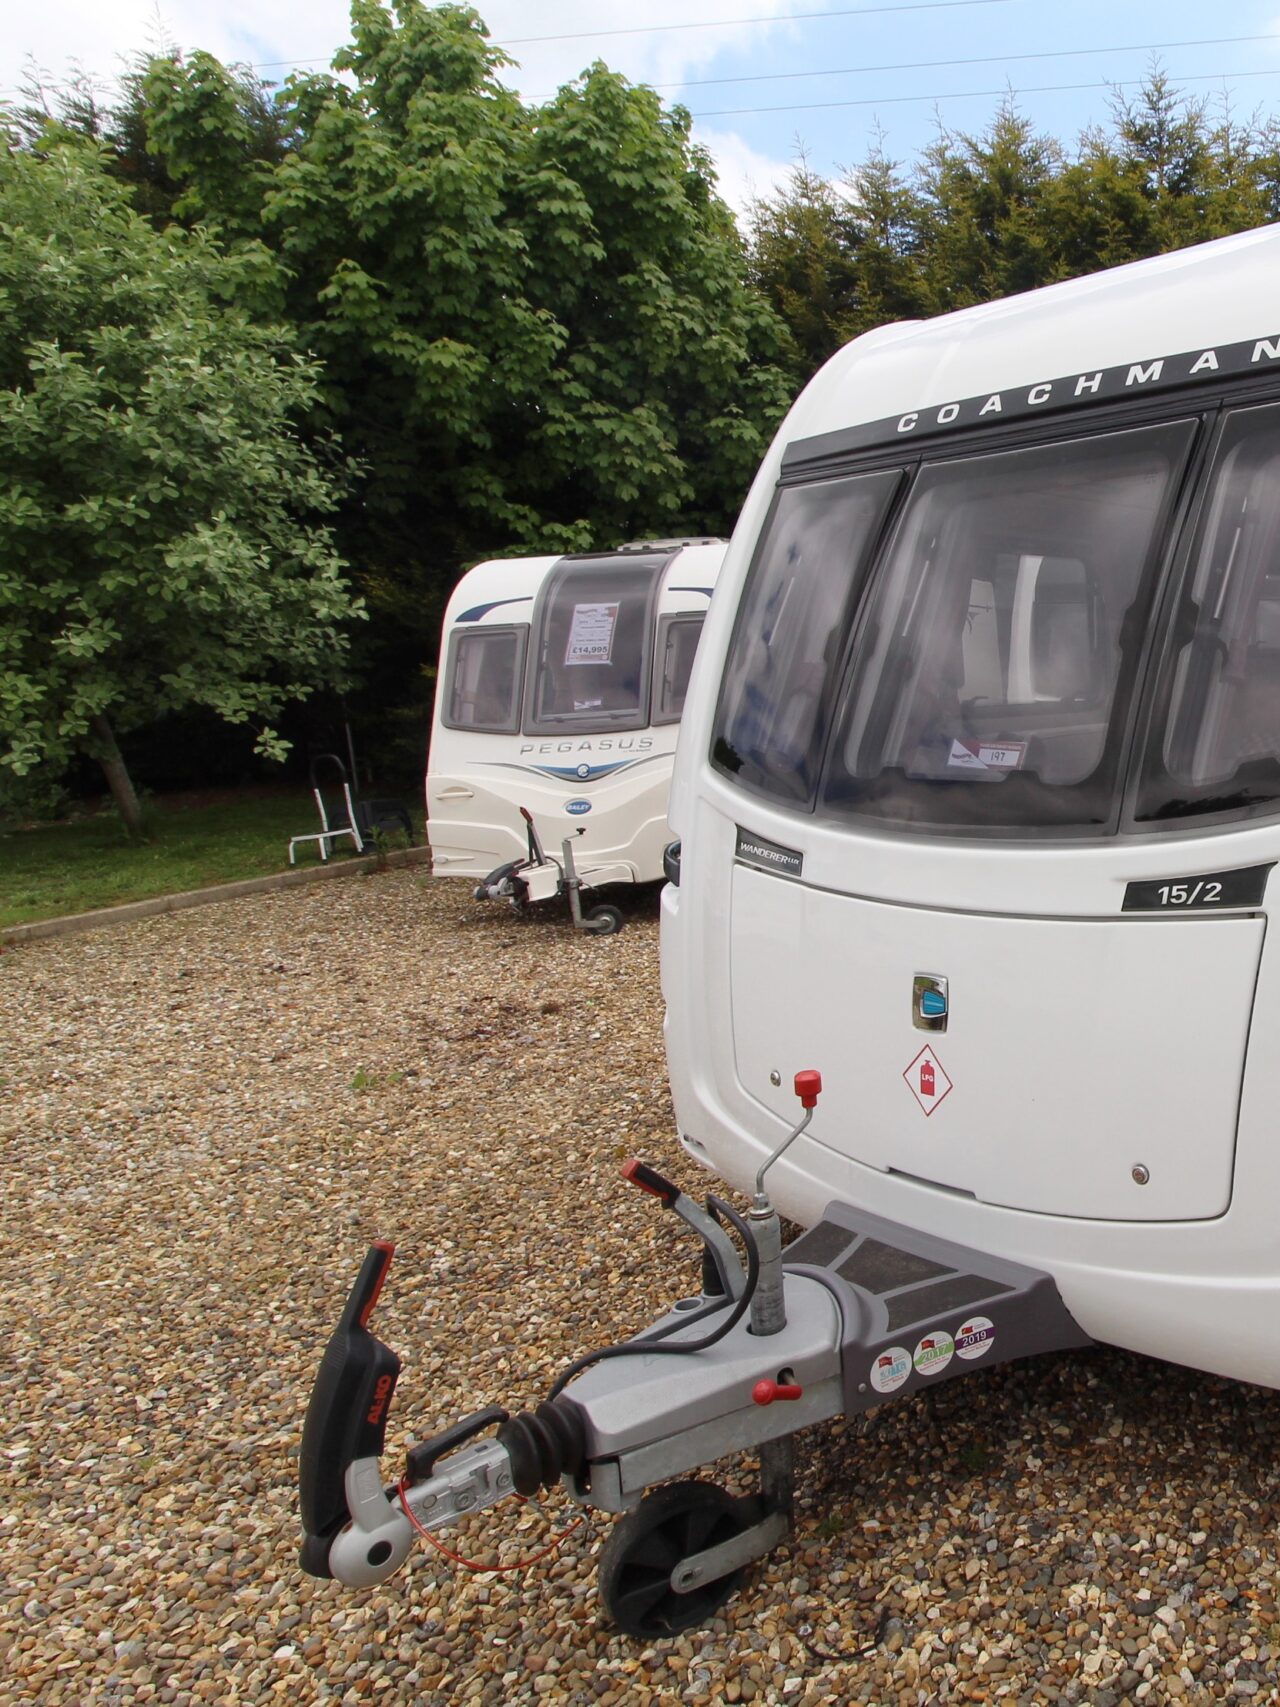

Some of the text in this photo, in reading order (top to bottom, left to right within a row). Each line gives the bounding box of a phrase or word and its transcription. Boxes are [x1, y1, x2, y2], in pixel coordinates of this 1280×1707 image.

[573, 646, 608, 654] £14,995
[520, 737, 654, 755] PEGASUS
[740, 842, 788, 864] WANDERER
[1158, 882, 1223, 905] 15/2
[922, 1074, 934, 1082] LPG
[962, 1330, 987, 1347] 2019
[921, 1344, 947, 1362] 2017
